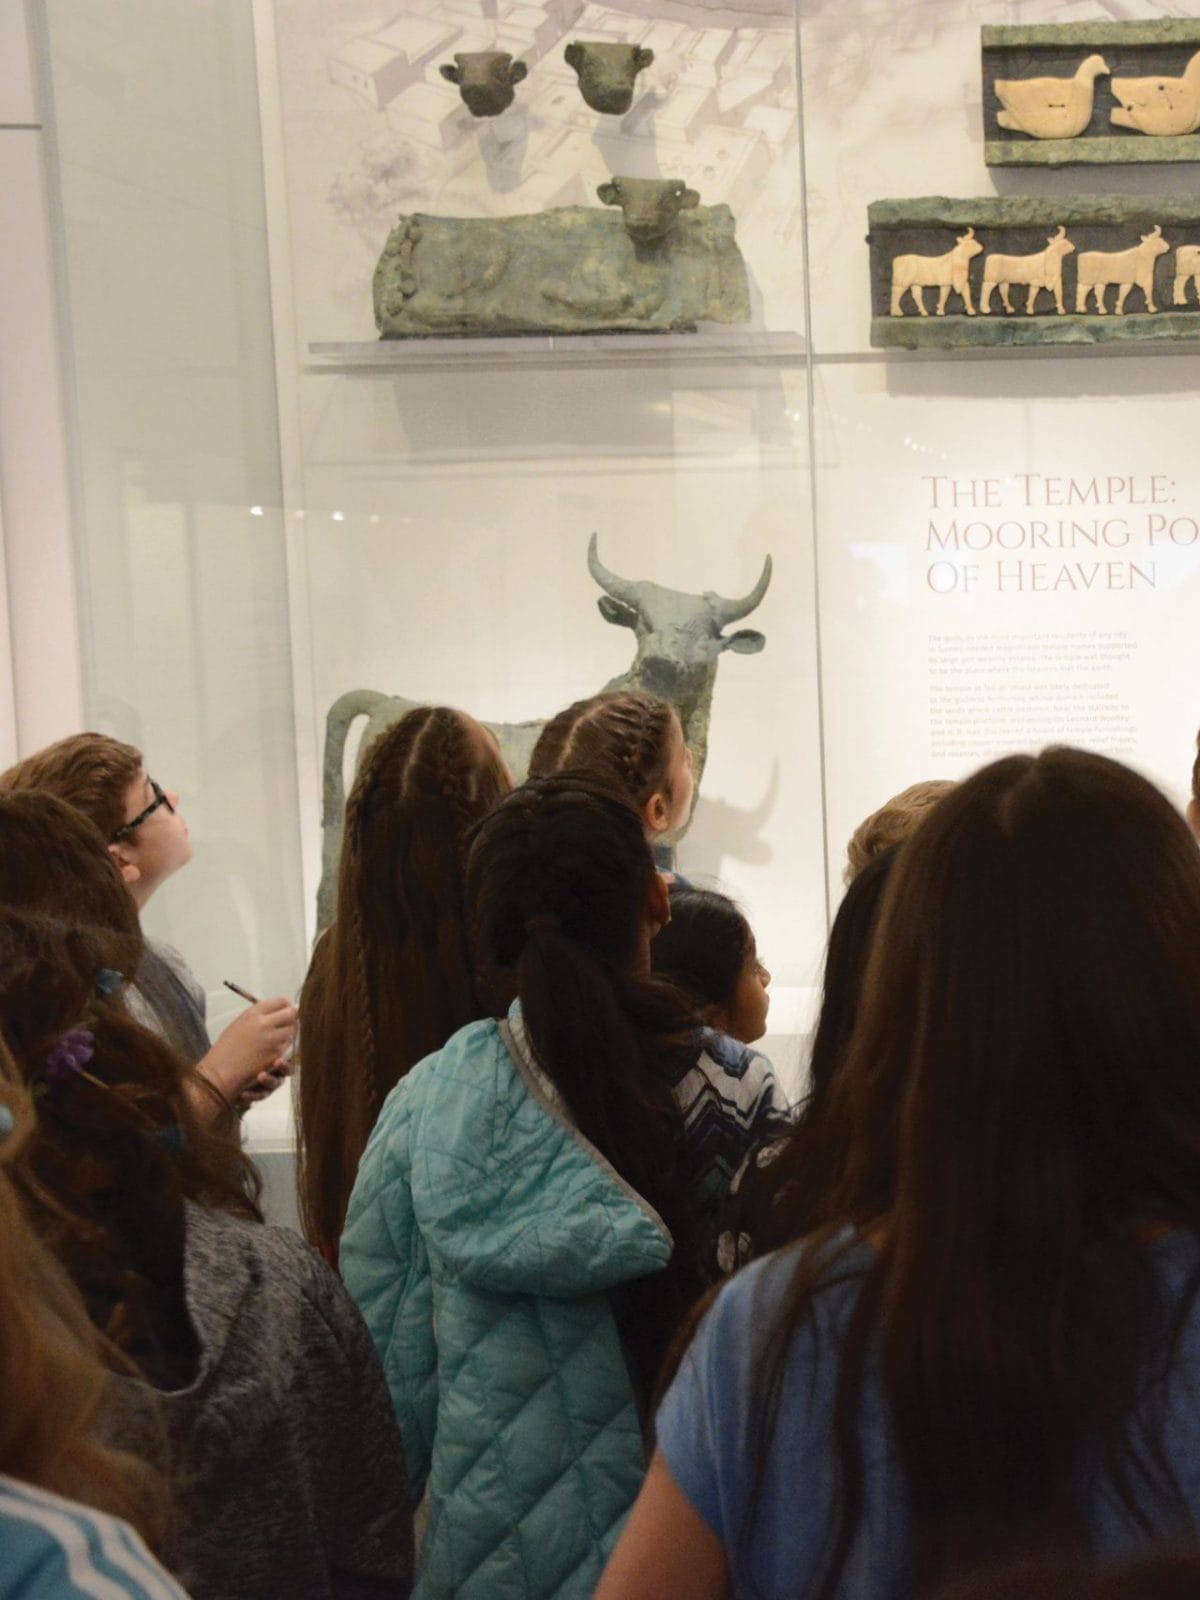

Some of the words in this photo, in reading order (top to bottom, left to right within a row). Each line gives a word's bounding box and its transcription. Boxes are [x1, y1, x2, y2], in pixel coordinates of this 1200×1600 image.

[922, 475, 1002, 508] THE
[1015, 473, 1177, 506] TEMPLE:
[926, 519, 1131, 551] MOORING
[927, 561, 980, 594] OF
[996, 560, 1157, 592] HEAVEN
